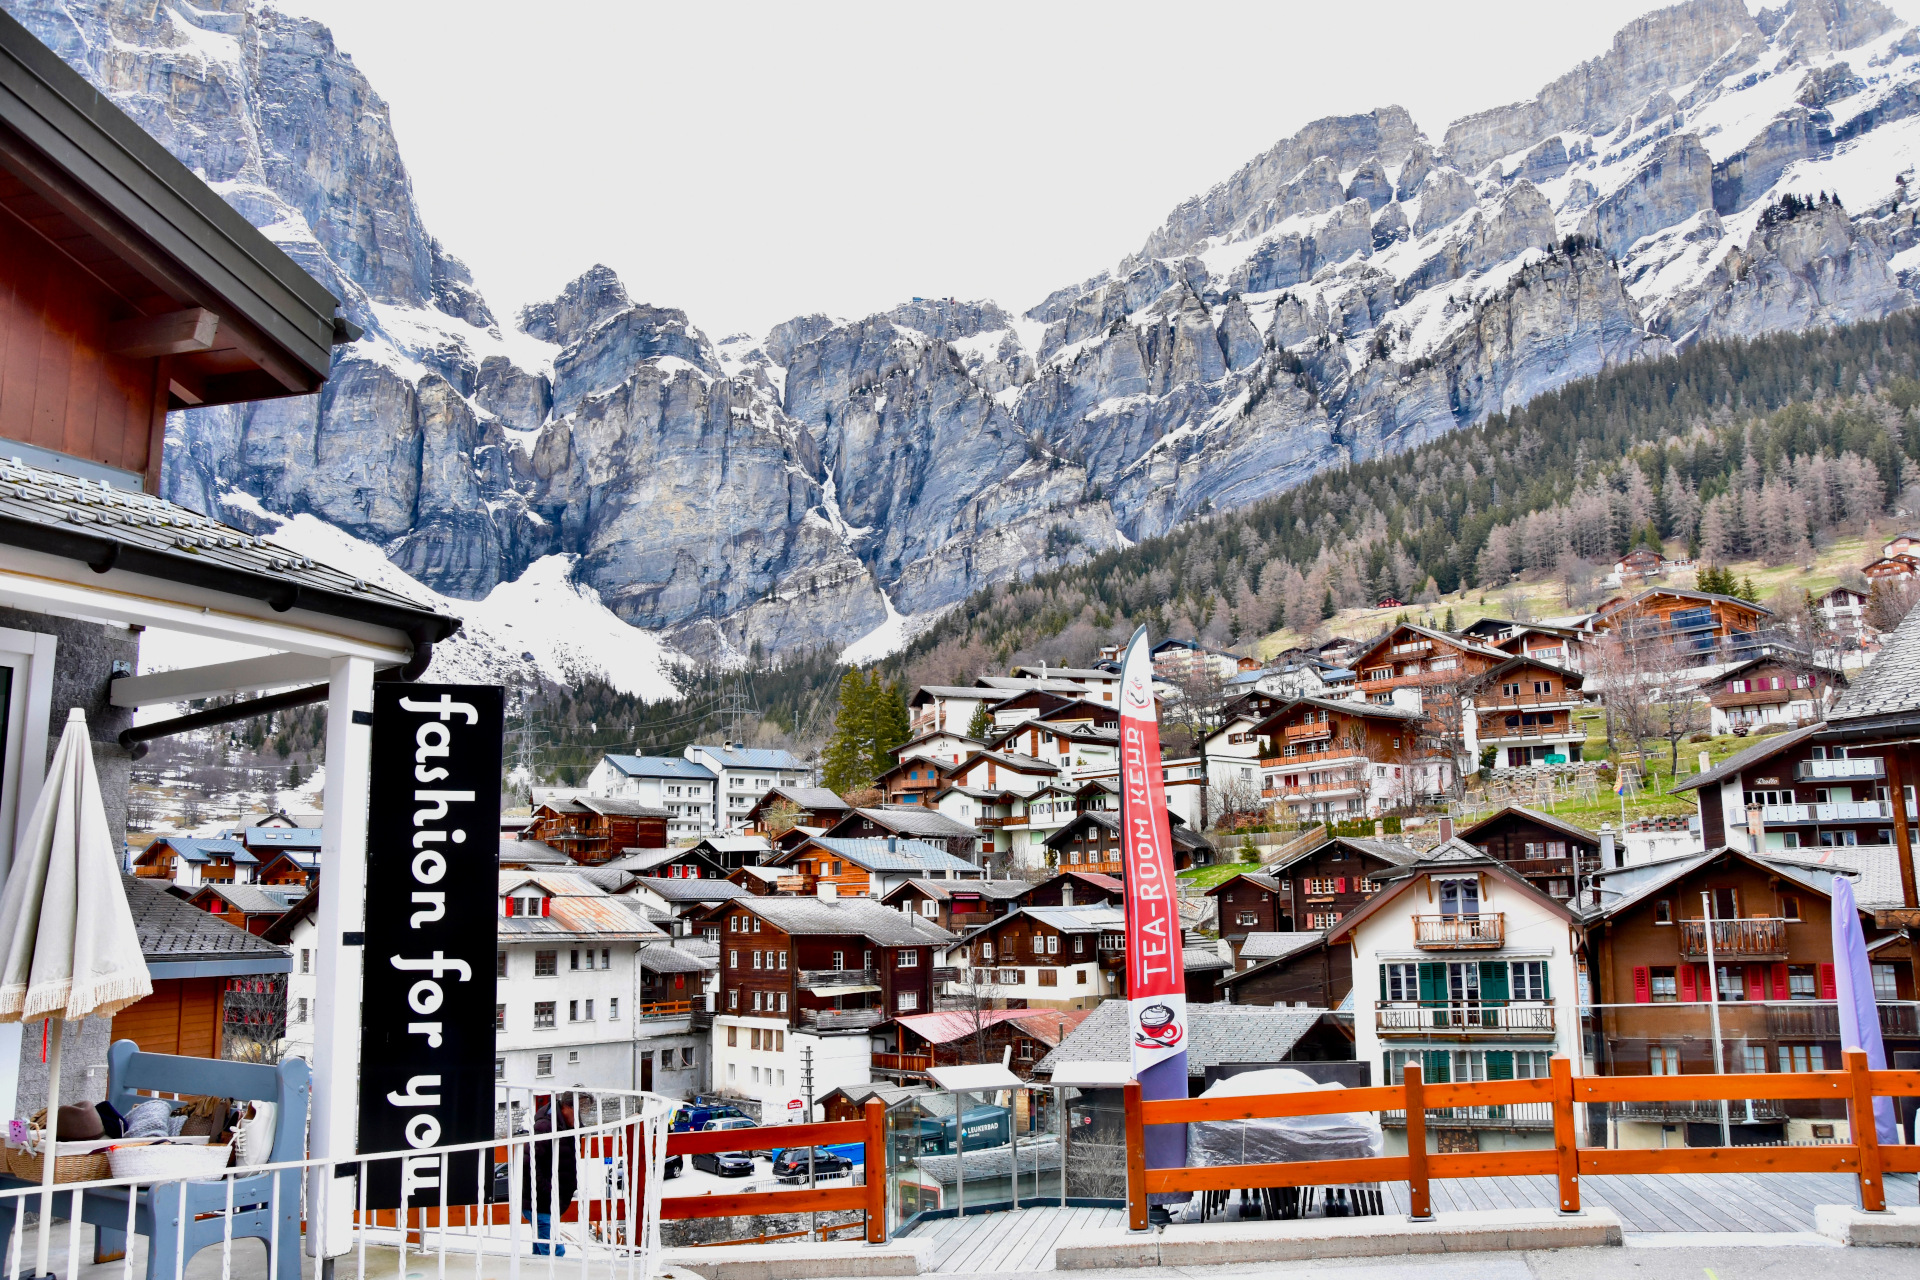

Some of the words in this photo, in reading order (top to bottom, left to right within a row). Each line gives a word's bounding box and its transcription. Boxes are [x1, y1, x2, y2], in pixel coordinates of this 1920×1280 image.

[399, 694, 478, 929] fashion
[1126, 727, 1146, 805] KEHR
[1134, 818, 1168, 985] TEA-ROOM
[390, 951, 472, 1048] for
[386, 1074, 441, 1196] you
[967, 1122, 999, 1134] LEUKERBAD
